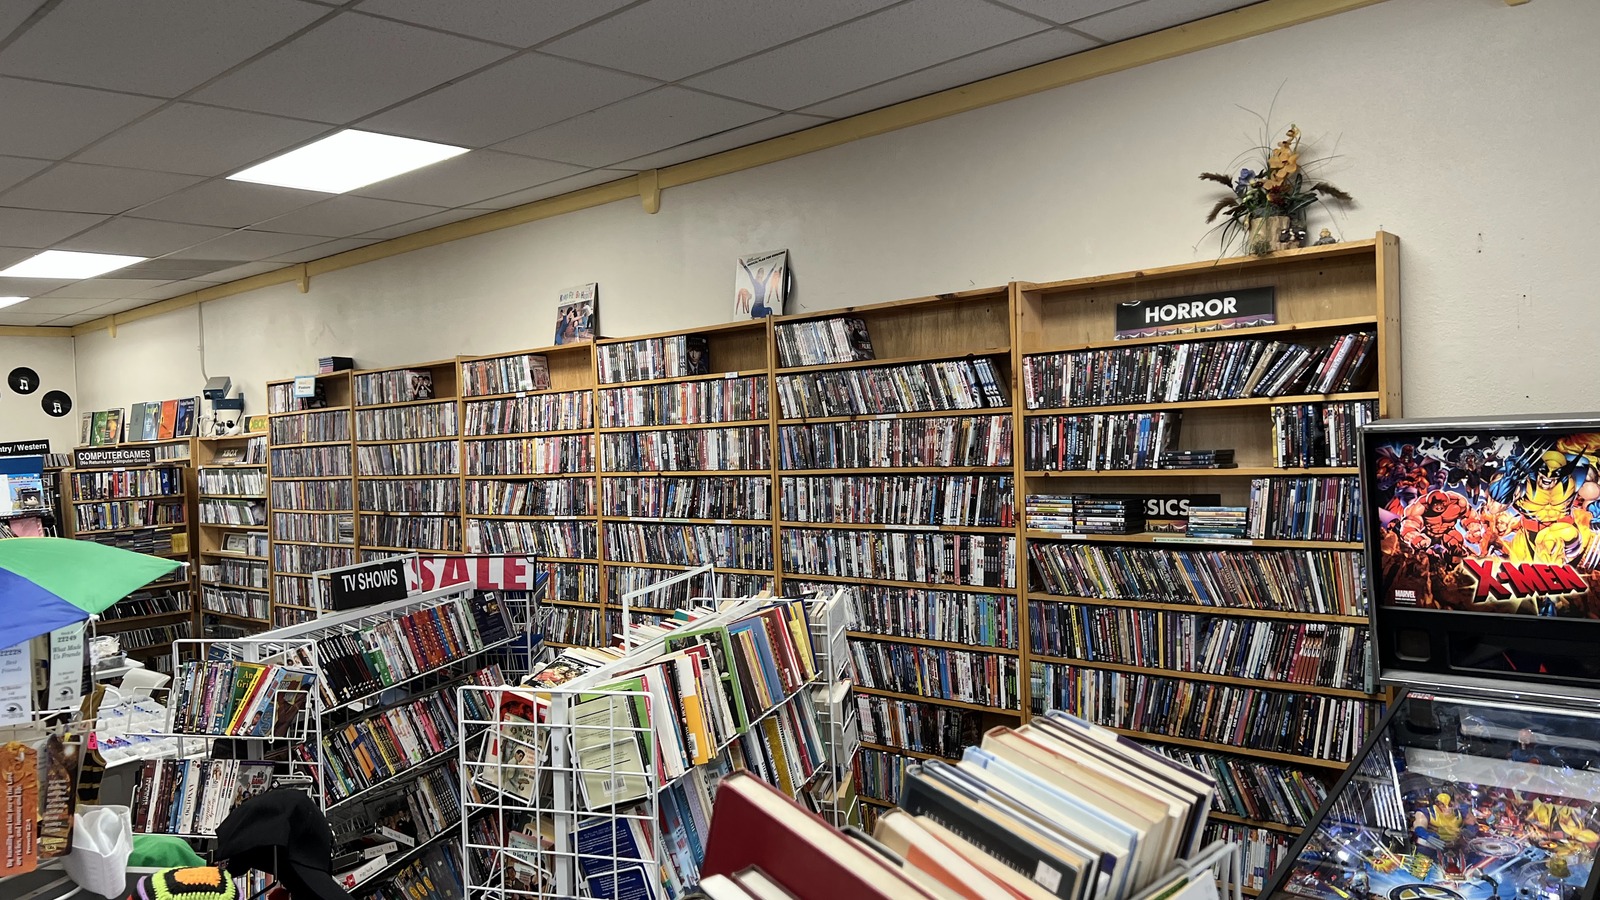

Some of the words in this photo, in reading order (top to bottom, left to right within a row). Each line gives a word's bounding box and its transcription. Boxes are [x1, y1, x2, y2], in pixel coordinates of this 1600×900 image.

[1145, 296, 1237, 323] HORROR
[250, 419, 266, 429] XBOX
[17, 443, 47, 451] Western
[78, 451, 122, 461] COMPUTER
[123, 450, 151, 459] GAMES
[411, 557, 527, 591] SALE
[341, 574, 357, 593] TV
[358, 569, 399, 590] SHOWS
[1463, 559, 1588, 603] X-MEN
[1394, 589, 1416, 598] MARVEL
[6, 772, 14, 785] Lord
[6, 786, 14, 795] the
[6, 823, 14, 834] and
[6, 834, 14, 858] humility
